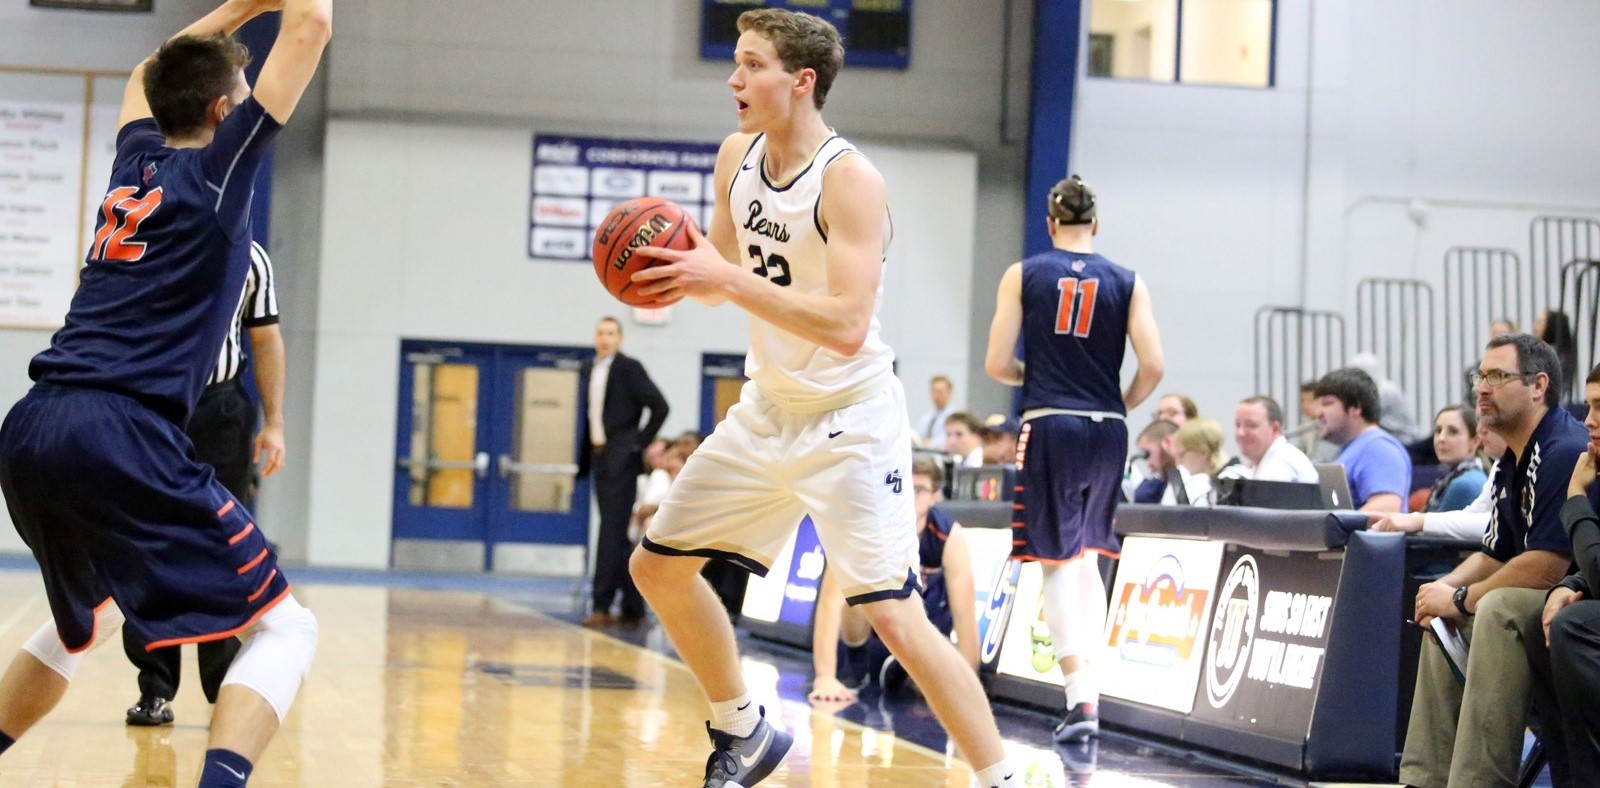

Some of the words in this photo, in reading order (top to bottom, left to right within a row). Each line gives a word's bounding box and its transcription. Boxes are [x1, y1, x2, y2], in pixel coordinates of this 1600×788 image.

[91, 186, 164, 262] 12
[613, 213, 673, 271] Wilson
[1054, 277, 1099, 338] 11
